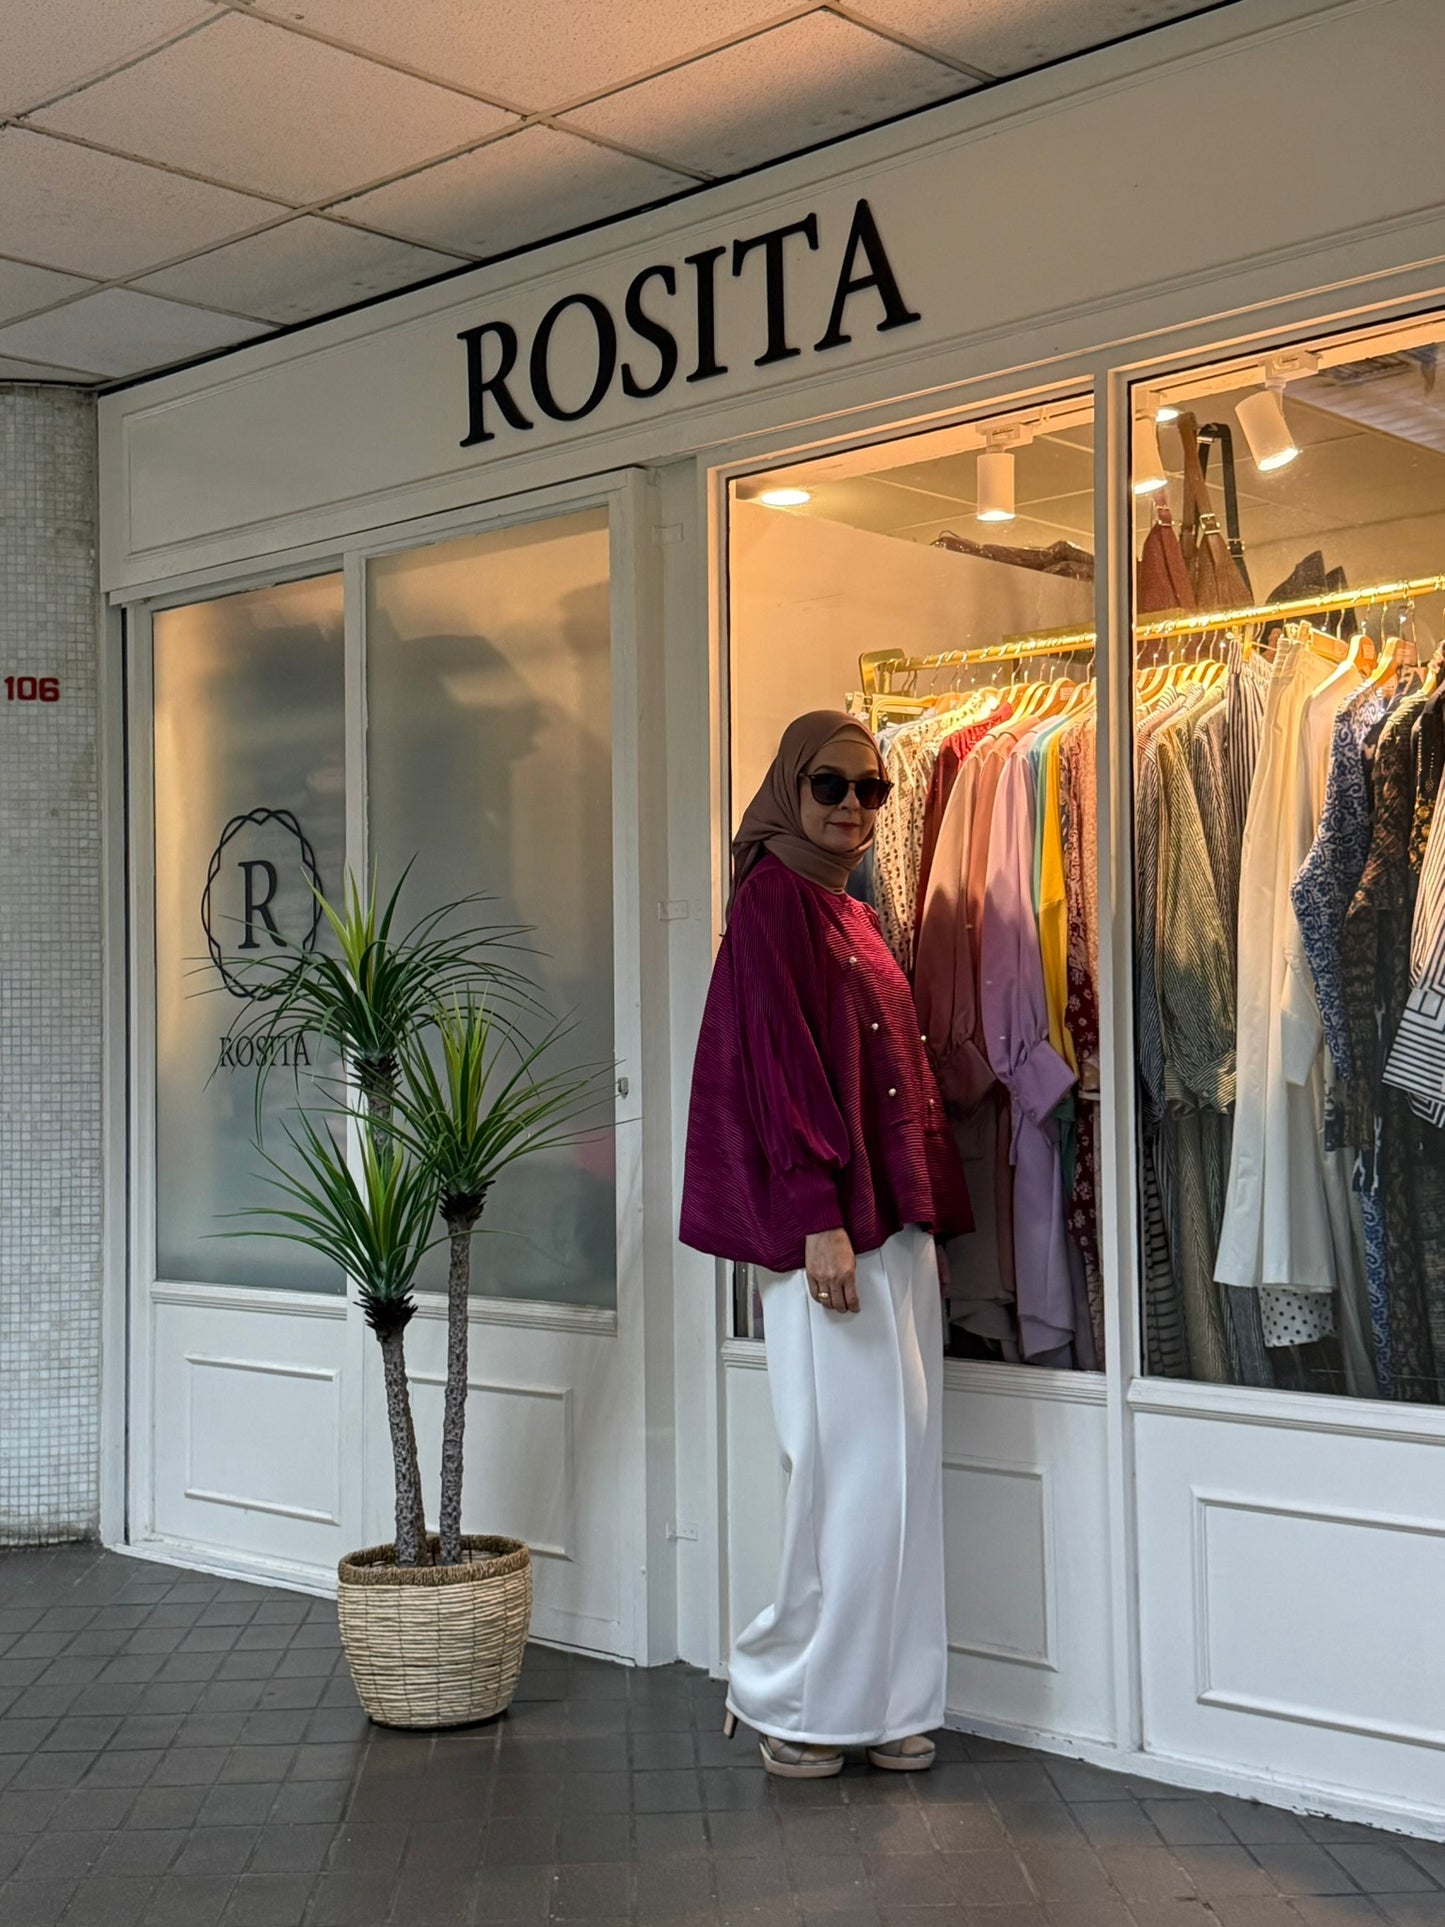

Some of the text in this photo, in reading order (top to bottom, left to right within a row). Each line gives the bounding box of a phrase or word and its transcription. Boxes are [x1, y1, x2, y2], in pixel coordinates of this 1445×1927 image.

[457, 198, 921, 448] ROSITA
[4, 675, 60, 702] 106
[237, 860, 287, 949] R
[219, 1031, 312, 1068] ROSITA
